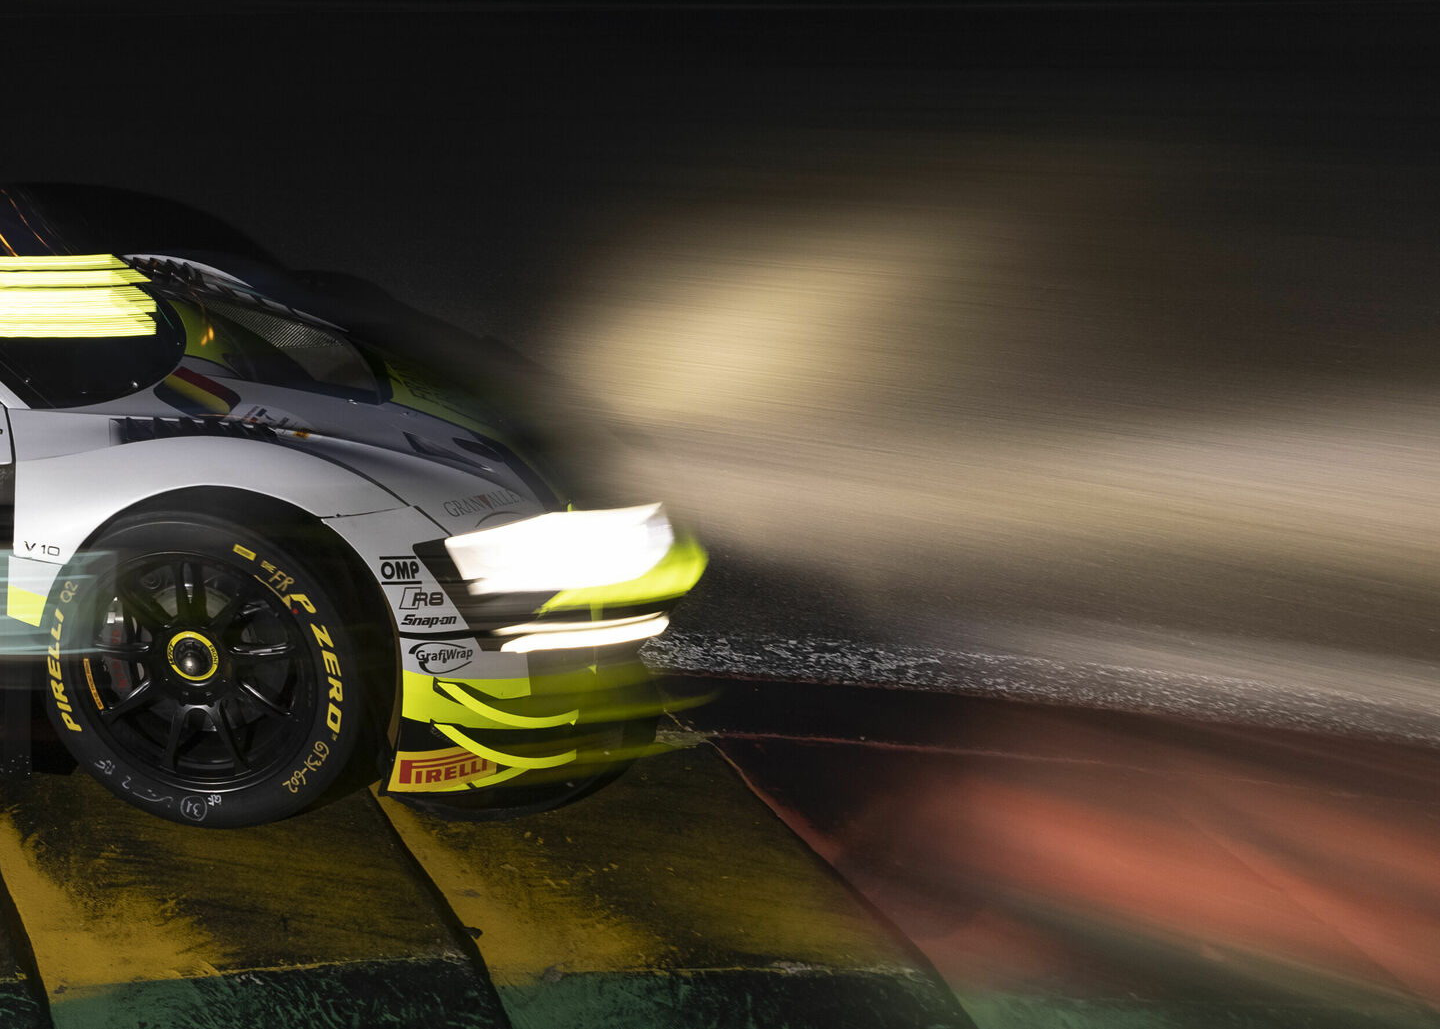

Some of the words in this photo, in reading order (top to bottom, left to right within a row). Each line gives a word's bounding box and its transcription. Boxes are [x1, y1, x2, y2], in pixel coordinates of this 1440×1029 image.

[380, 561, 419, 580] OMP
[400, 614, 457, 628] Snap-on
[289, 593, 317, 614] P
[310, 623, 343, 734] ZERO
[416, 647, 473, 663] GrafiWrap
[48, 609, 82, 732] PIRELLI
[399, 752, 488, 784] PIRELLI
